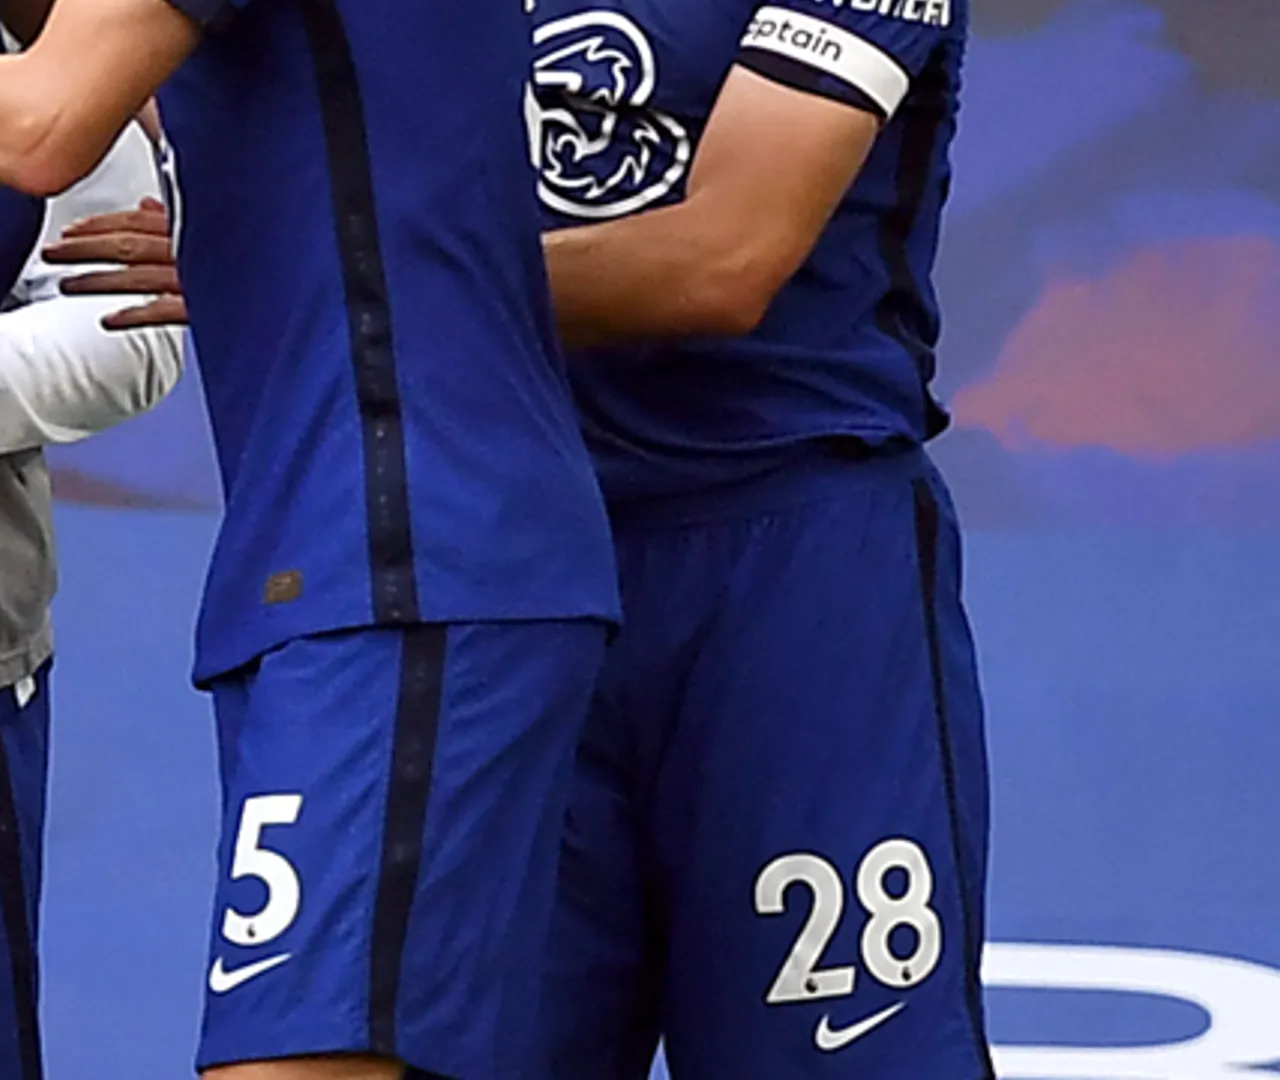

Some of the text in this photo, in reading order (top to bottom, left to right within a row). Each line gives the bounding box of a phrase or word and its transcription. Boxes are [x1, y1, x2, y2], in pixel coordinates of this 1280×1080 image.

[748, 17, 844, 62] ptain
[221, 793, 304, 947] 5
[754, 837, 943, 1004] 28
